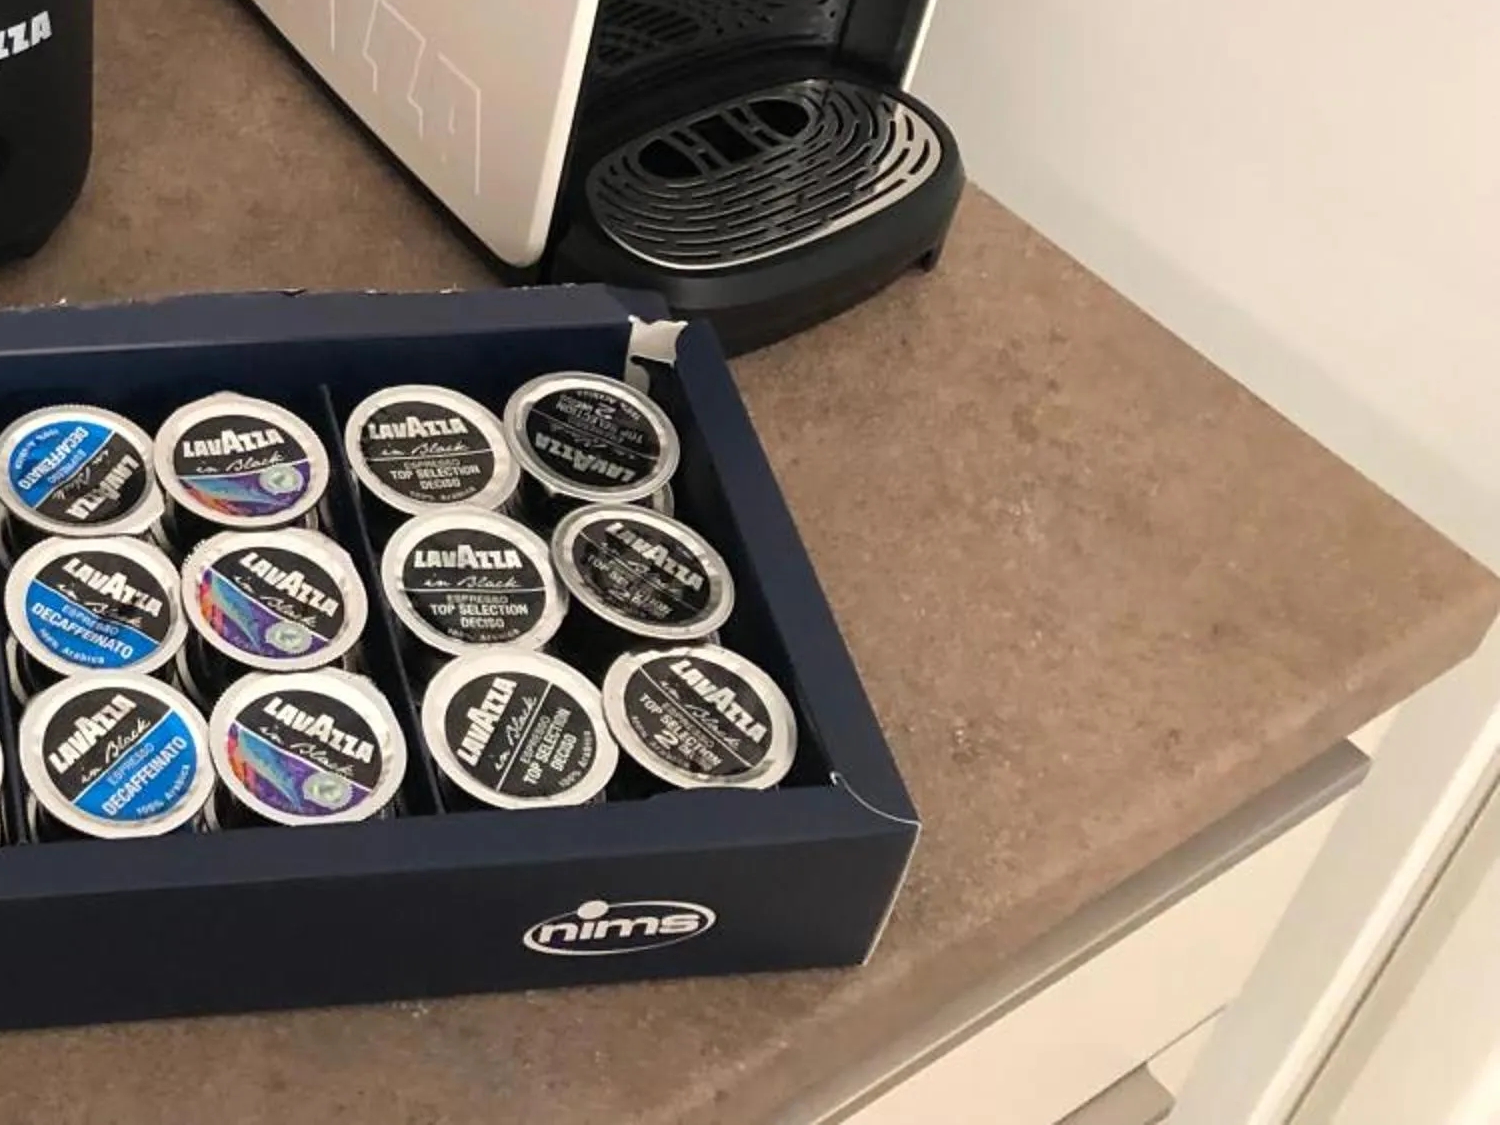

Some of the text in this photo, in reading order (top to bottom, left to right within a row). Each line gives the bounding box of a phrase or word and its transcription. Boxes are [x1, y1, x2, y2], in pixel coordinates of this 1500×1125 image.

[183, 429, 285, 458] LAVAZZA
[368, 416, 469, 440] LAVAZZA
[411, 442, 472, 457] Black
[17, 426, 89, 490] DECAFFEINATO
[225, 451, 285, 472] Black
[389, 464, 481, 480] TOP SELECTION
[534, 432, 637, 483] LAVAZZA
[65, 454, 140, 520] LAVAZZA
[419, 479, 461, 490] DECISO
[414, 544, 523, 569] LAVAZZA
[605, 522, 705, 591] LAVAZZA
[62, 557, 163, 618] LAVAZZA
[239, 552, 339, 617] LAVAZZA
[446, 594, 508, 604] ESPRESSO
[457, 575, 522, 588] Black
[31, 602, 134, 660] DECAFFEINATO
[430, 604, 529, 616] TOP SELECTION
[460, 616, 505, 628] DECISO
[457, 677, 518, 767] LAVAZZA
[506, 694, 538, 746] Black
[669, 658, 767, 744] LAVAZZA
[48, 694, 138, 775] LAVAZZA
[105, 718, 151, 764] Black
[263, 696, 375, 764] LAVAZZA
[523, 708, 572, 785] TOP SELECTION
[639, 693, 663, 715] TOP
[660, 714, 723, 765] SELECTION
[107, 742, 155, 786] ESPRESSO
[290, 742, 355, 775] Black
[551, 733, 577, 772] DECISO
[101, 736, 188, 816] DECAFFEINATO
[537, 900, 701, 943] nims
